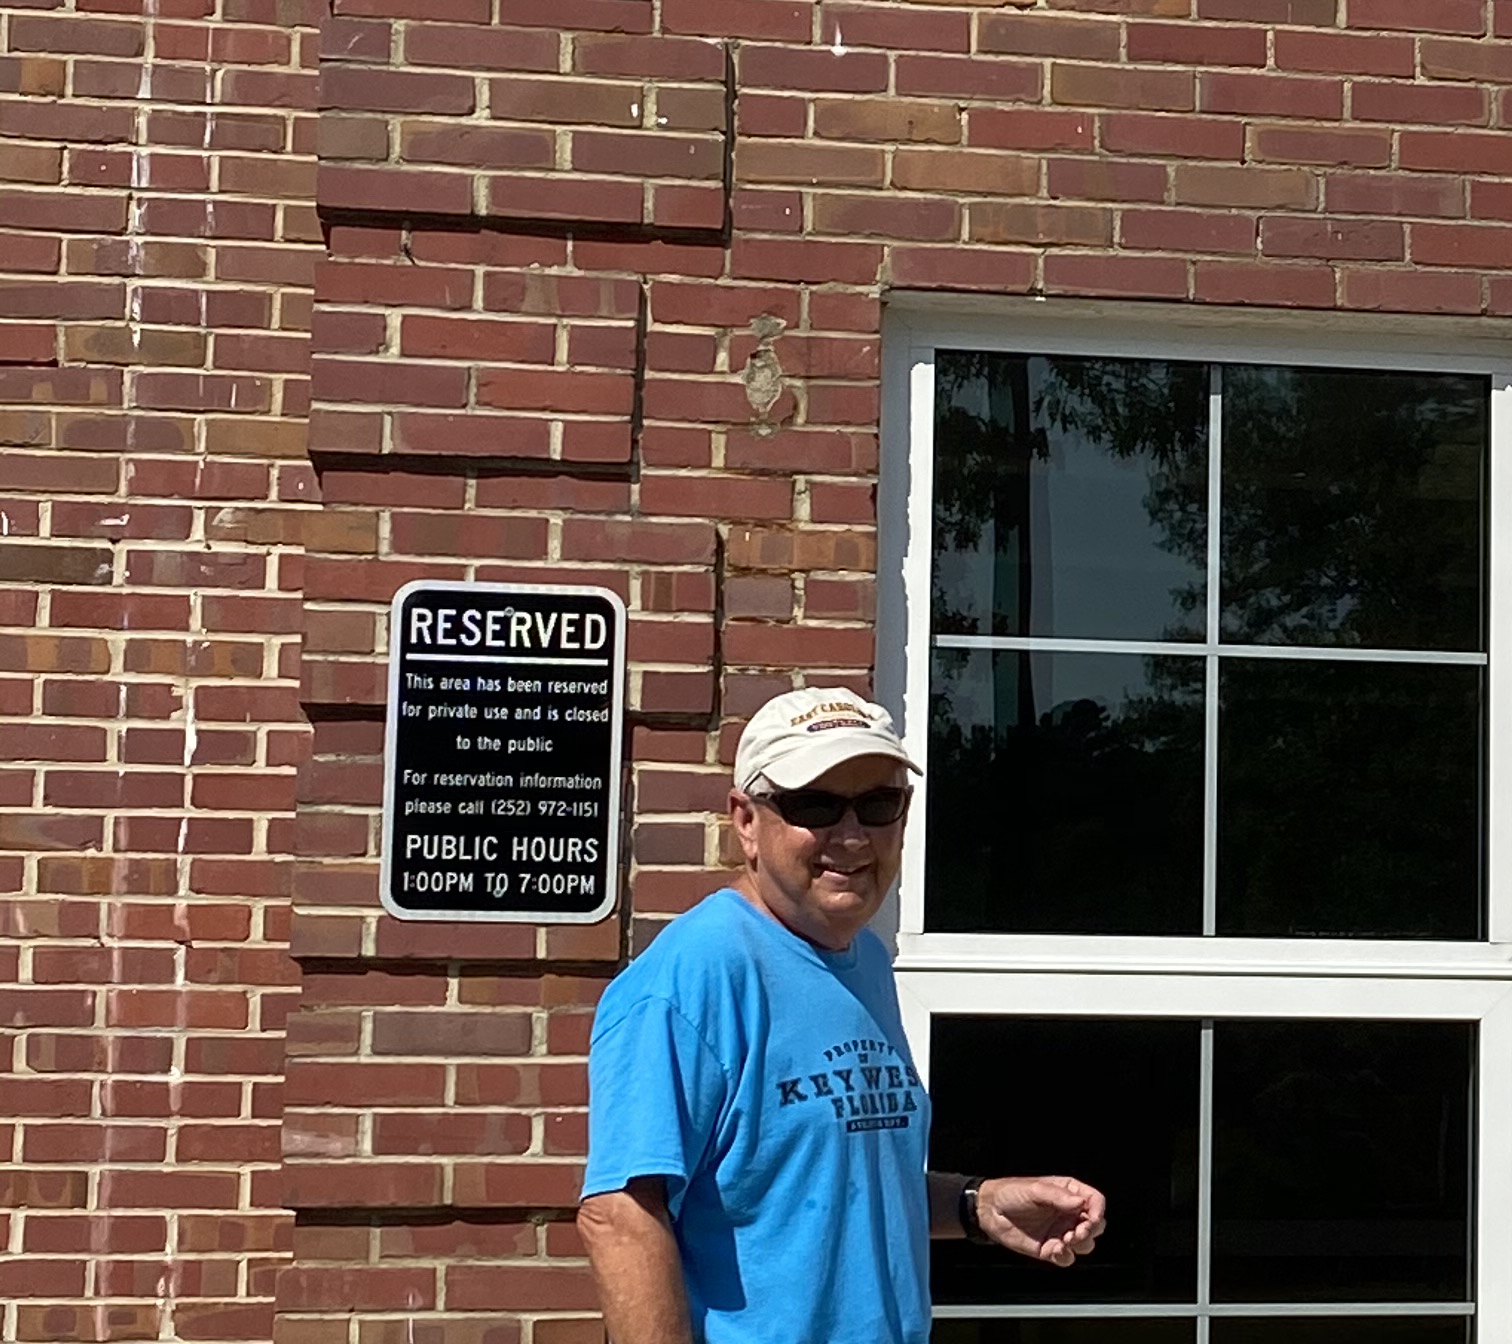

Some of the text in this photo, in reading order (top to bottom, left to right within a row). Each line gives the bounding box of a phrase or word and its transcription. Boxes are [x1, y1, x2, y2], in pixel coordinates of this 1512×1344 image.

[409, 608, 607, 651] RESERVED
[405, 672, 609, 695] This area has been reserved
[402, 701, 609, 723] for private use and is closed
[456, 735, 553, 754] to the public
[403, 769, 603, 790] For reservation information
[404, 798, 599, 818] please call (252) 972-1151
[406, 834, 599, 863] PUBLIC HOURS
[403, 871, 596, 896] 1:00PM TO 7:00PM
[823, 1039, 895, 1062] PROPERTY
[776, 1066, 919, 1105] KEY WES
[831, 1090, 918, 1120] FLORIDA
